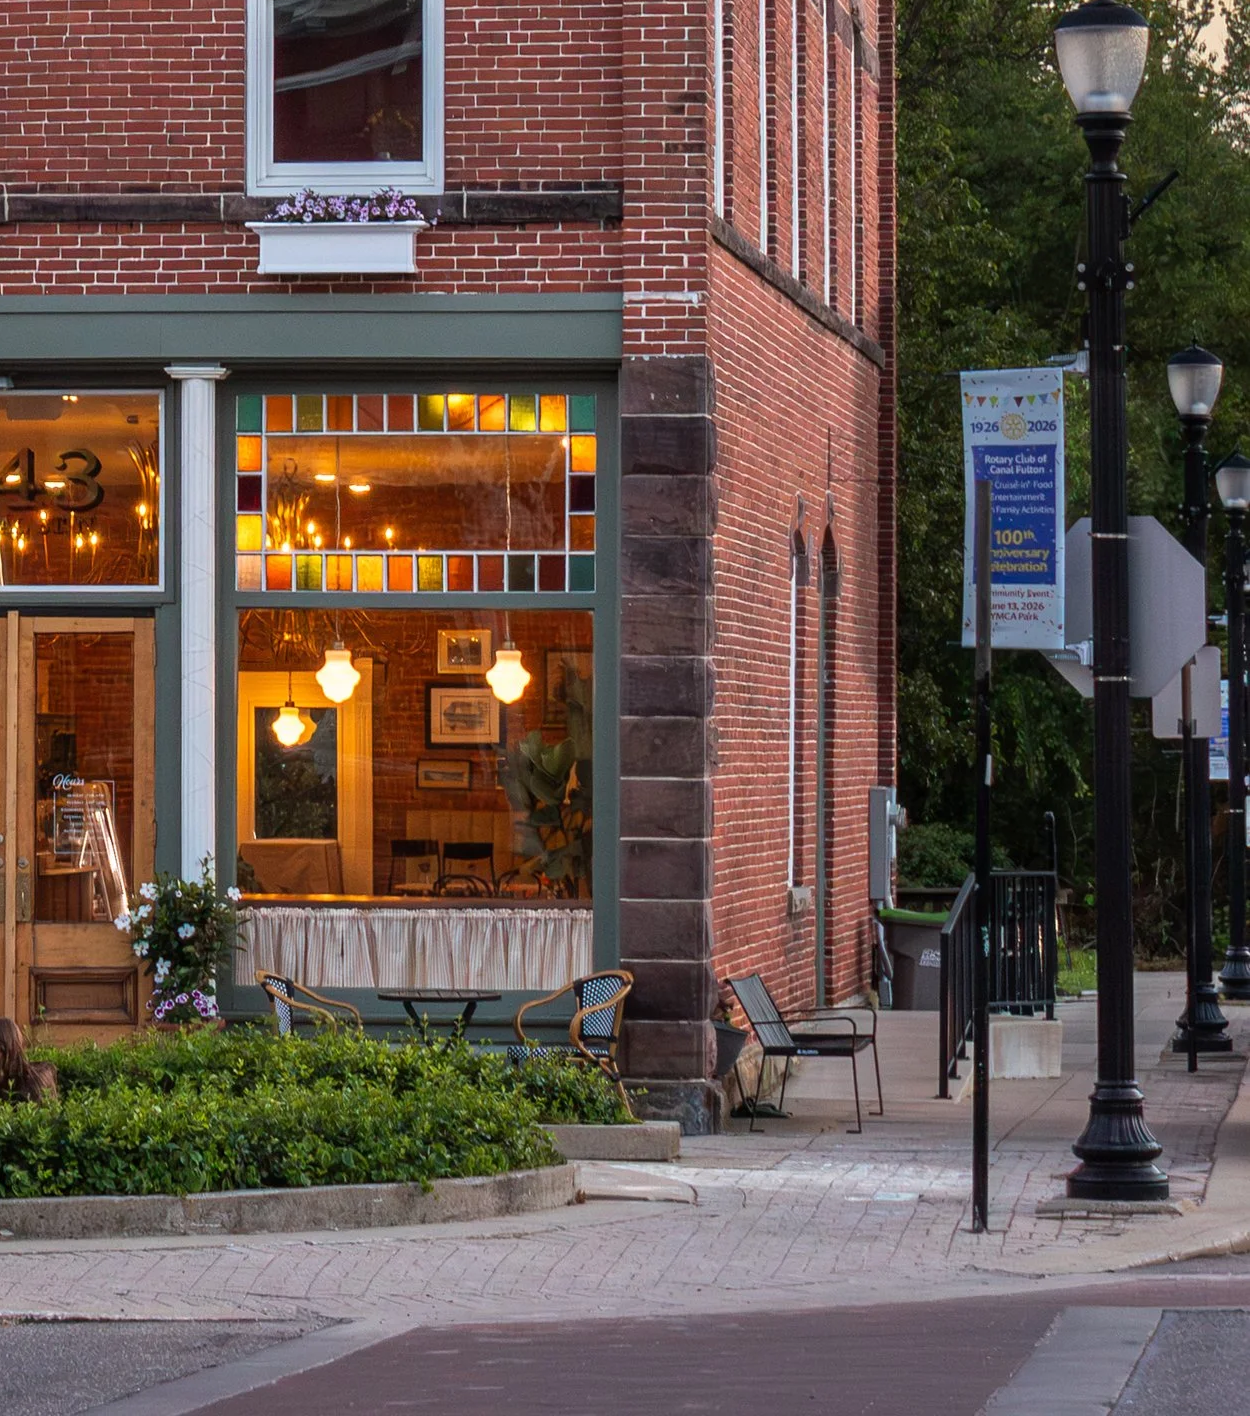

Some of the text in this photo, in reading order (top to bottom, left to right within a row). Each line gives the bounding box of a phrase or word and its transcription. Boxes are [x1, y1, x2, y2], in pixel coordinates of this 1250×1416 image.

[970, 420, 1057, 433] 1926 2026
[984, 453, 1047, 465] Rotary Club of
[990, 464, 1045, 474] Canal Fulton
[1033, 480, 1053, 489] Food
[996, 506, 1019, 515] Family
[1021, 506, 1054, 514] Activities
[994, 529, 1034, 545] 100th
[990, 549, 1049, 561] nniversary
[990, 561, 1048, 572] elebration
[990, 589, 1025, 599] mmunity
[990, 602, 1006, 610] une
[1021, 601, 1045, 611] 2026
[990, 612, 1039, 621] YMCA Park
[53, 774, 85, 790] Hours
